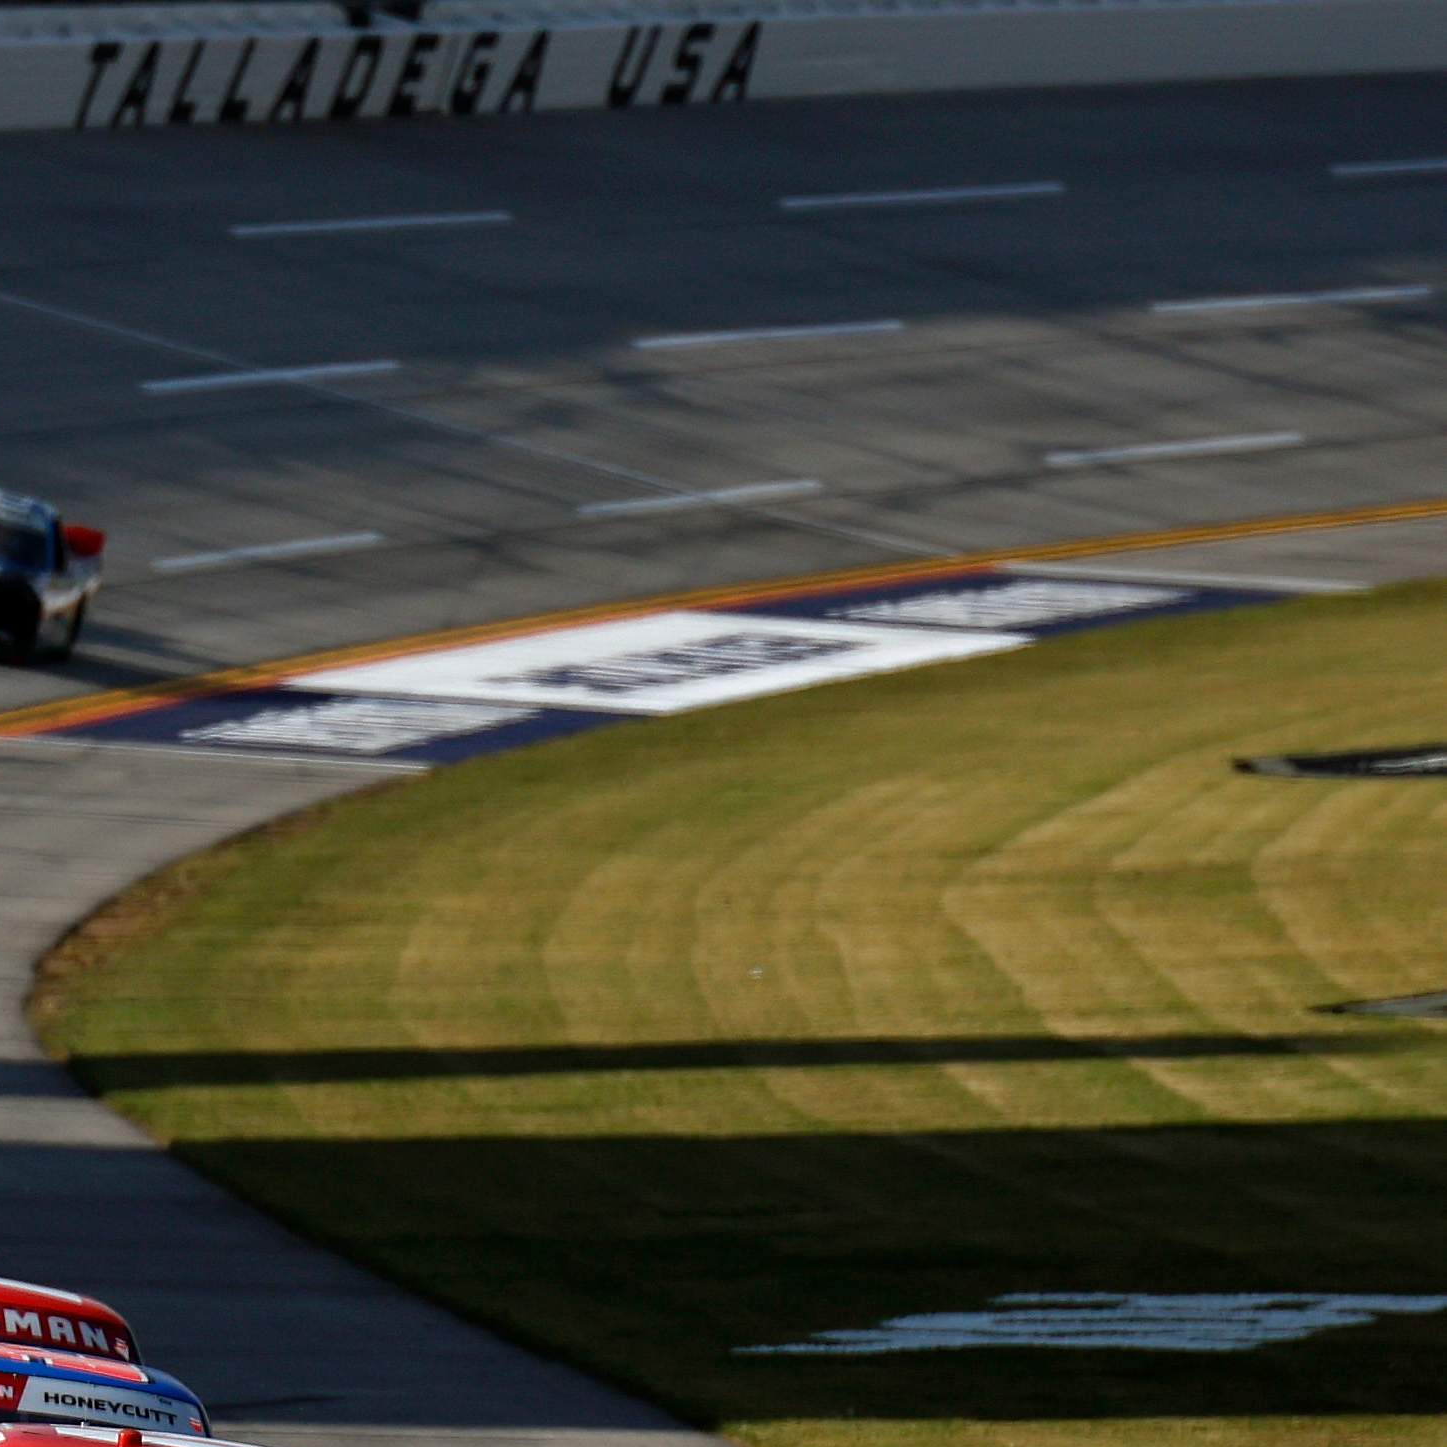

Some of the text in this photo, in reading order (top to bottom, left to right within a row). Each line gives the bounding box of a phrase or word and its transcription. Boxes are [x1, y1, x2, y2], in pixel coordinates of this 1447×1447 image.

[73, 21, 763, 131] TALLADEGA USA
[44, 1391, 178, 1426] HONEYCUTT
